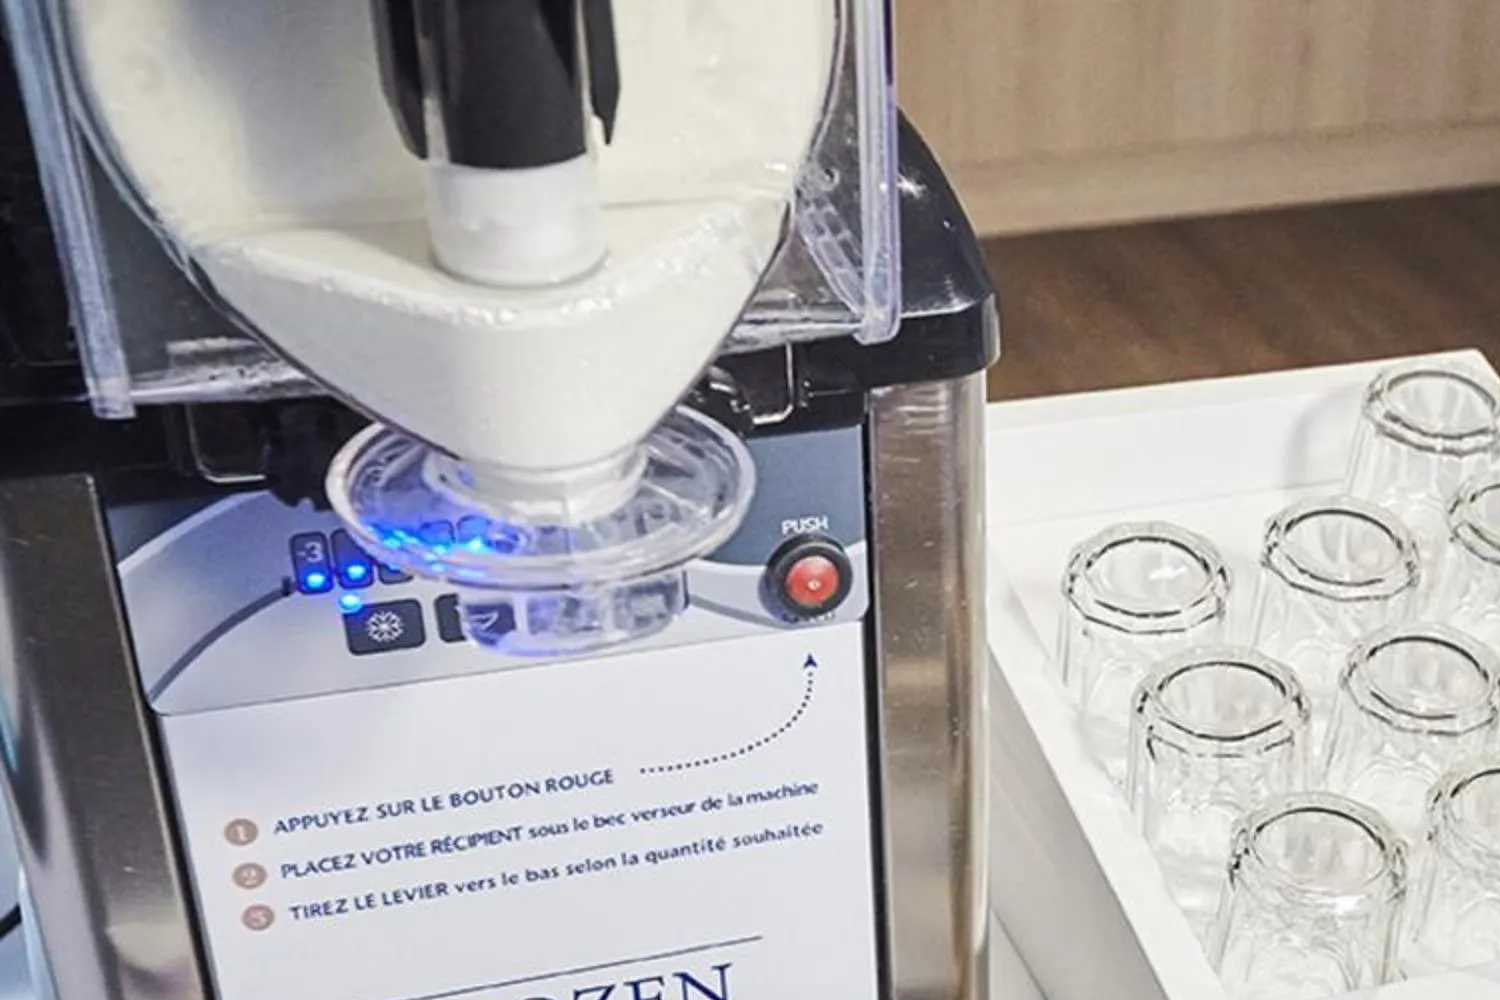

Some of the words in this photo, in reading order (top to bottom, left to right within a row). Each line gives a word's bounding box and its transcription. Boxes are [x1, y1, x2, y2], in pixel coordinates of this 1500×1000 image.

[781, 515, 829, 535] PUSH
[273, 806, 369, 834] APPUYEZ
[376, 799, 416, 820] SUR
[421, 795, 445, 812] LE
[449, 781, 541, 808] BOUTON
[545, 768, 615, 793] ROUGE
[280, 853, 357, 879] PLACEZ
[360, 842, 426, 866] VOTRE
[430, 825, 523, 855] RÉCIPIENT
[528, 822, 570, 839] sous
[573, 816, 590, 832] le
[592, 812, 626, 828] bec
[630, 801, 697, 822] verseur
[700, 796, 724, 812] de
[727, 792, 744, 807] la
[746, 782, 820, 804] machine
[289, 898, 349, 921] TIREZ
[354, 892, 377, 911] LE
[381, 882, 449, 907] LEVIER
[454, 876, 497, 893] vers
[501, 871, 520, 886] le
[525, 865, 560, 883] bas
[565, 856, 617, 876] selon
[621, 852, 640, 866] la
[644, 836, 727, 865] quantité
[732, 821, 825, 849] souhaitée
